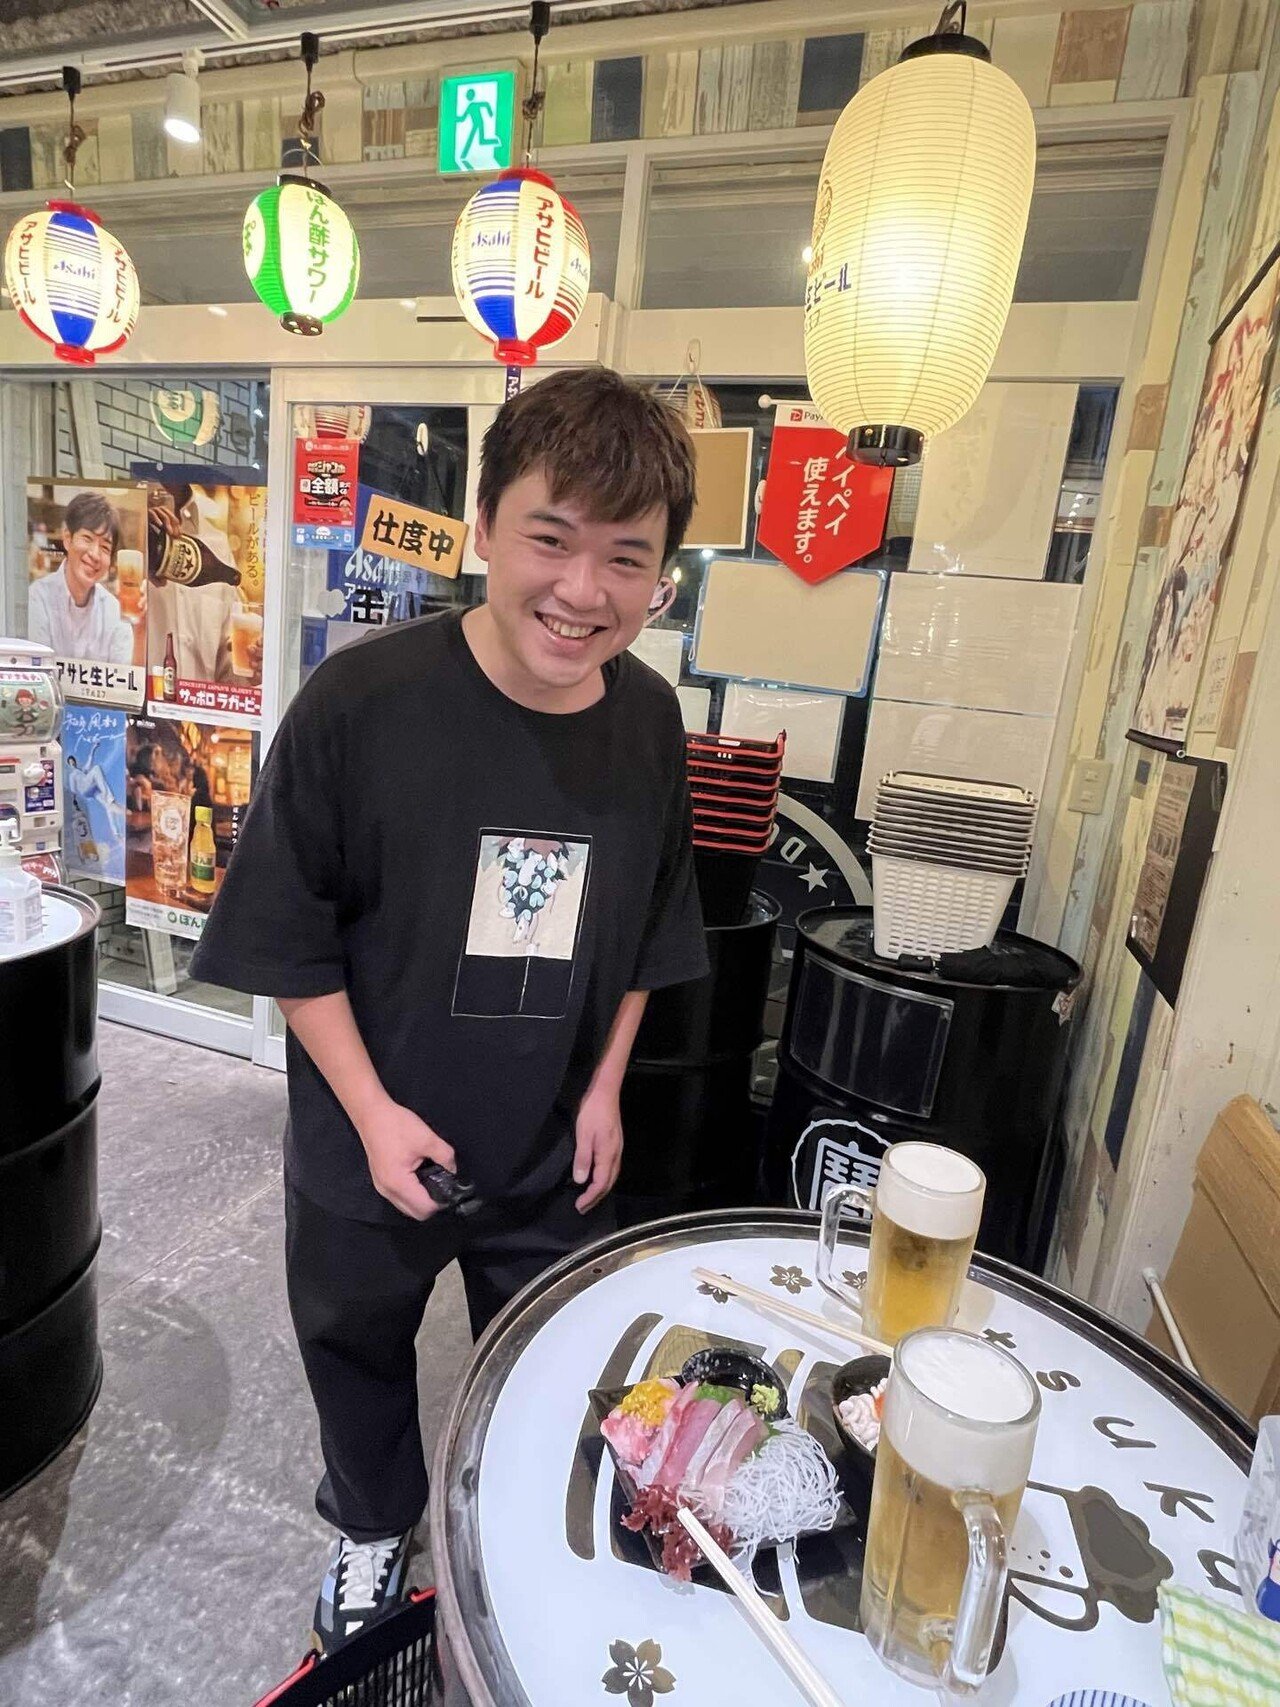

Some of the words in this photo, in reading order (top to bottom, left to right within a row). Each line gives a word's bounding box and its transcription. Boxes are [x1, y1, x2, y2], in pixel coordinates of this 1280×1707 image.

[471, 231, 510, 248] Asahi
[525, 196, 554, 299] アサヒビール
[19, 221, 38, 305] アサヒビール
[53, 260, 96, 279] Asahi
[804, 412, 823, 423] Pay
[793, 456, 830, 563] 使えます。
[372, 510, 455, 561] 仕度中
[56, 661, 139, 692] アサヒ生ビール
